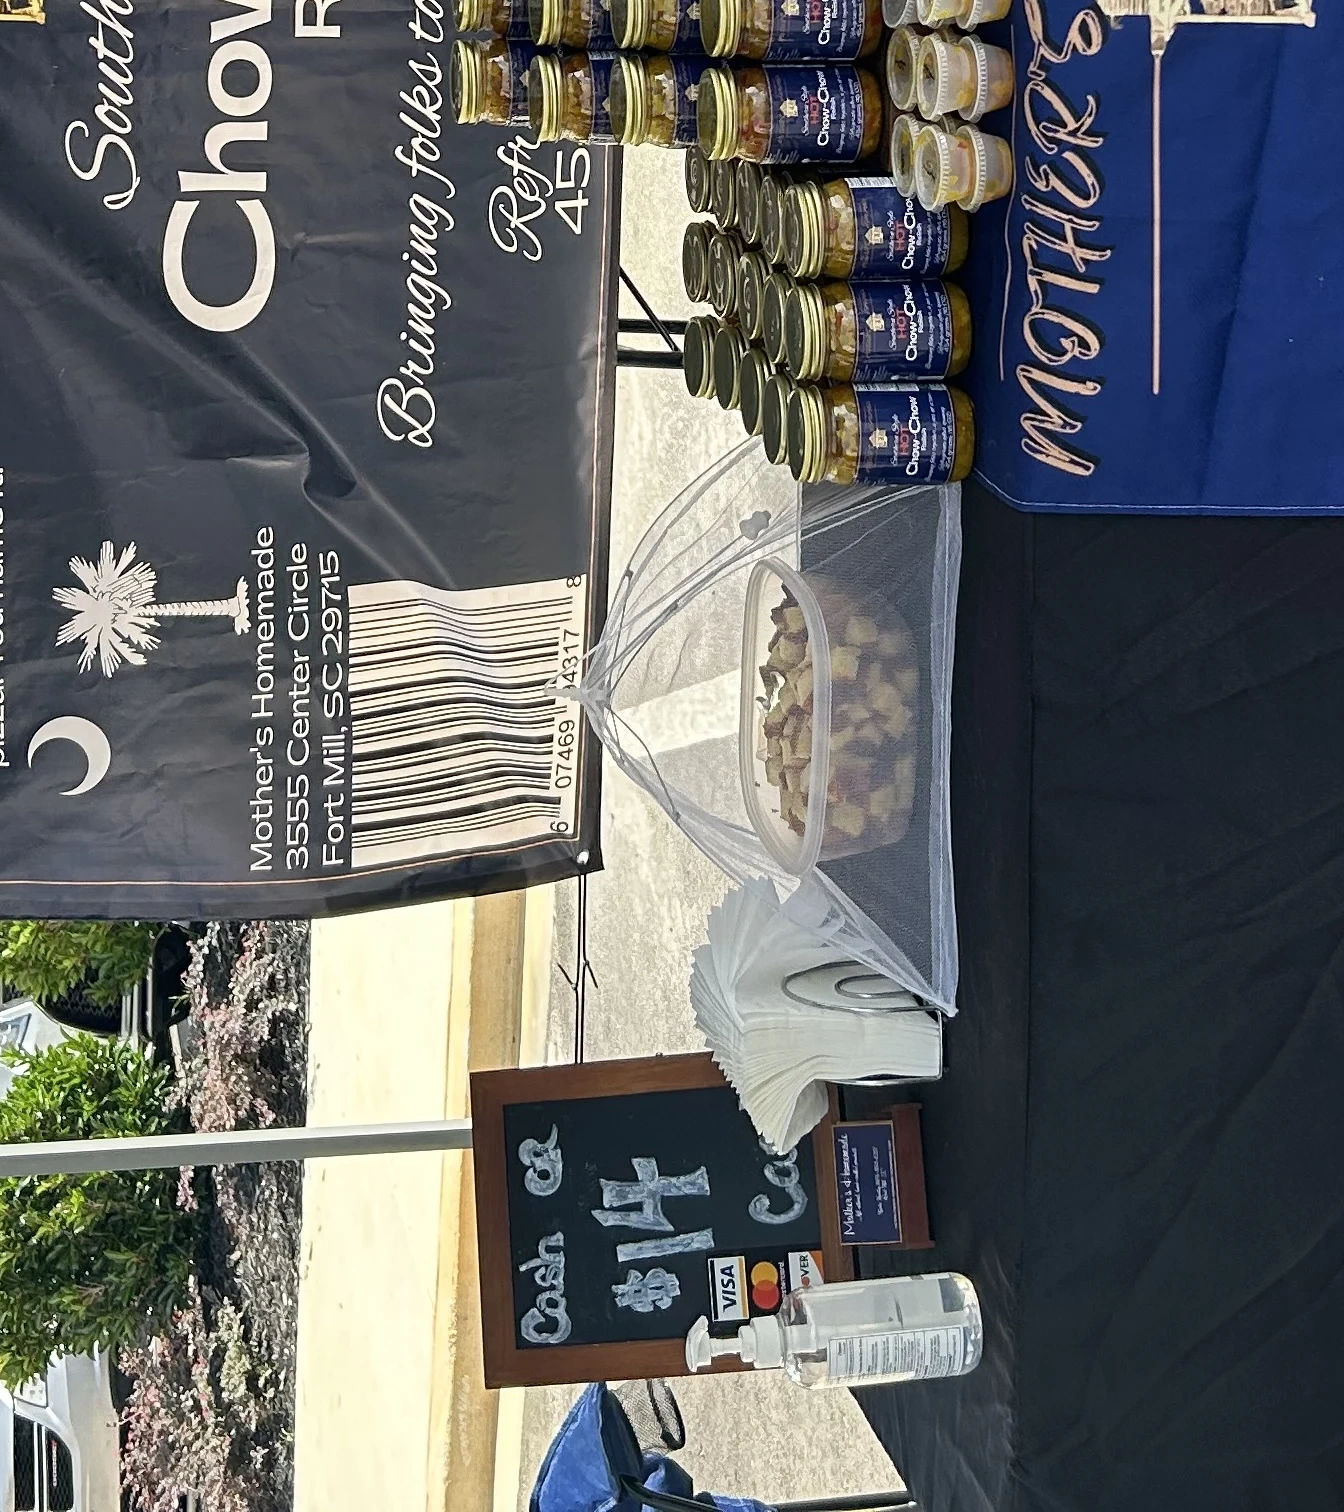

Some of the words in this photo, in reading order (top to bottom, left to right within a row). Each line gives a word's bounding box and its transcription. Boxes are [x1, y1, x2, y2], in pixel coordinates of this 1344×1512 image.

[395, 53, 455, 195] folks
[555, 148, 590, 234] 45
[377, 194, 454, 447] Bringing
[903, 284, 919, 361] Chow-Chow
[907, 395, 920, 475] Chow-Chow
[251, 527, 274, 717] Homemade
[286, 543, 309, 641] Circle
[319, 551, 342, 654] 29715
[564, 575, 583, 588] 8
[287, 650, 310, 765] Center
[322, 663, 343, 718] SC
[250, 727, 273, 871] Mother's
[322, 727, 348, 786] Mill,
[555, 720, 575, 788] 07469
[287, 775, 309, 869] 3555
[323, 793, 344, 865] Fort
[550, 821, 568, 832] 6
[591, 1158, 714, 1312] $14
[519, 1231, 571, 1343] Cash
[720, 1265, 736, 1312] VISA
